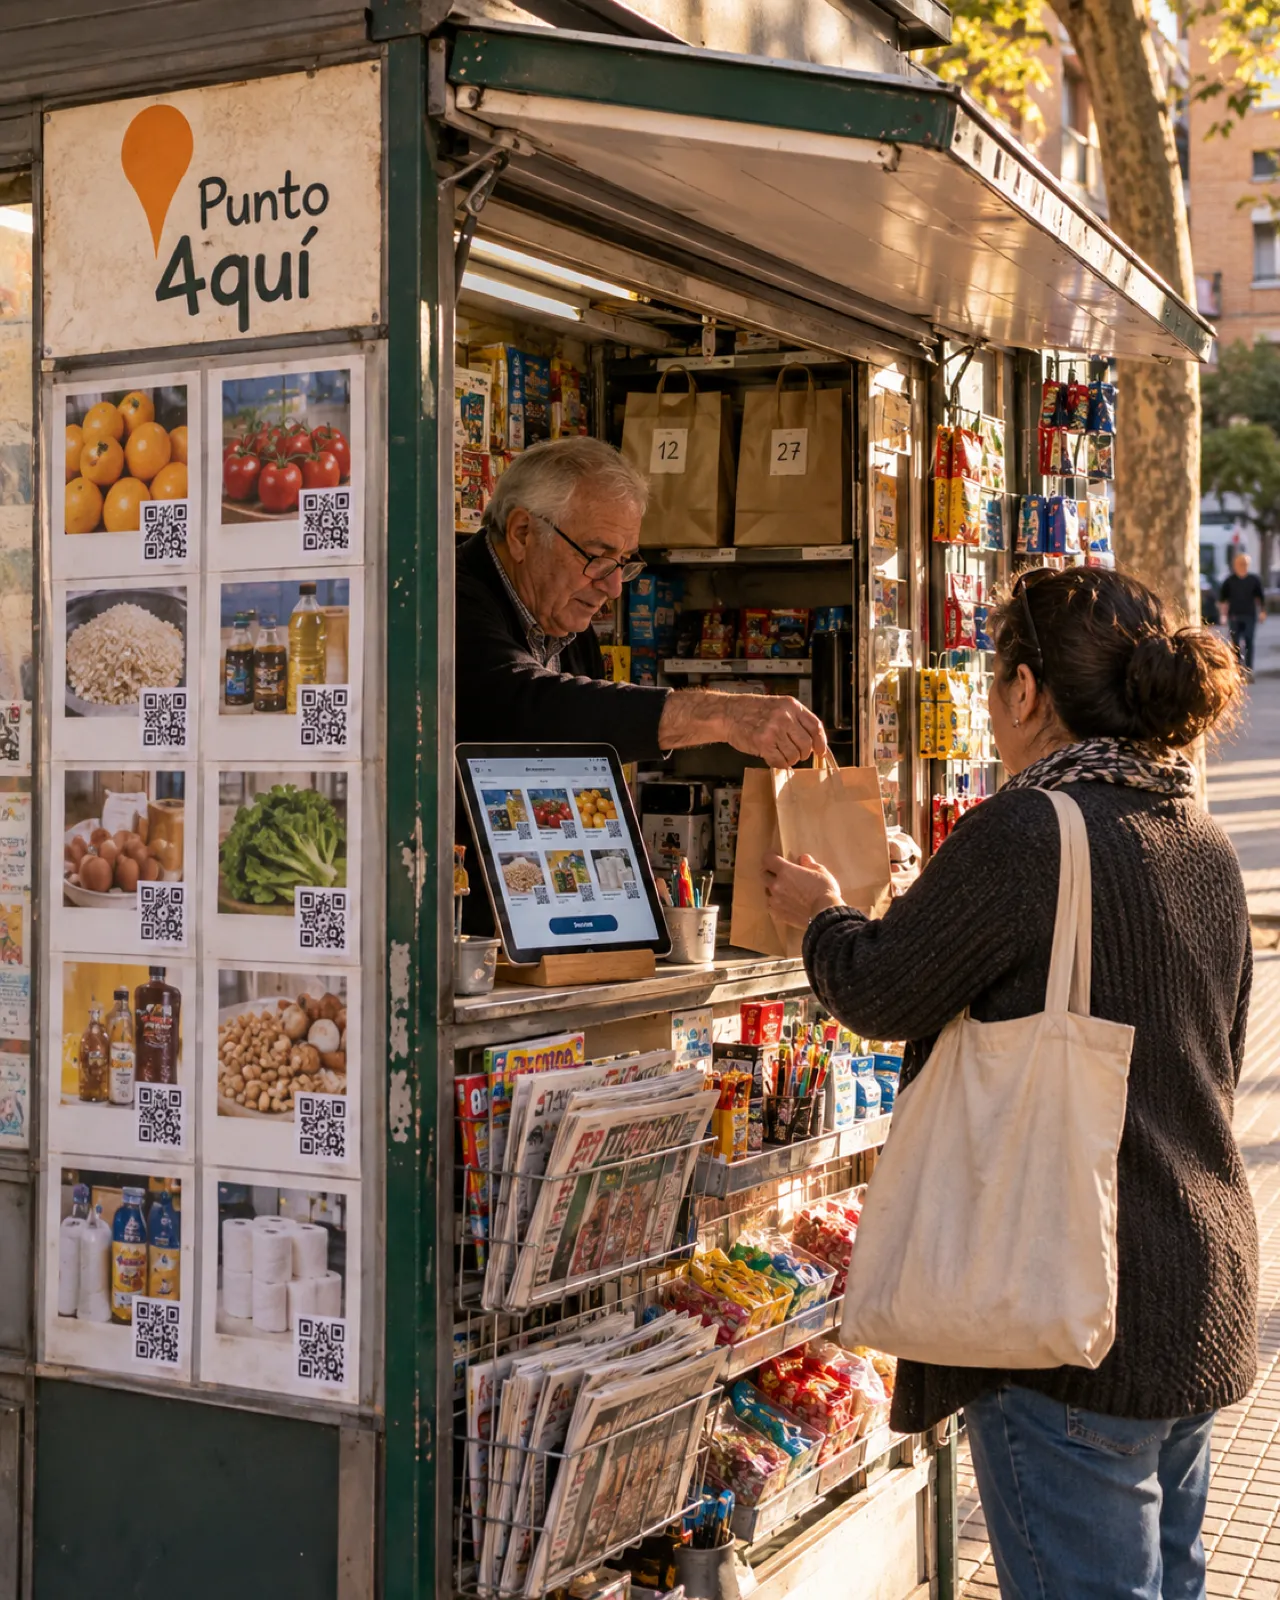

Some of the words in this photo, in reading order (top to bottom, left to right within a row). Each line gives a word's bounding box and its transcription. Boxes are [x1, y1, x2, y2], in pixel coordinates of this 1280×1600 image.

[198, 169, 330, 230] Punto
[657, 440, 679, 460] 12
[776, 441, 801, 461] 27
